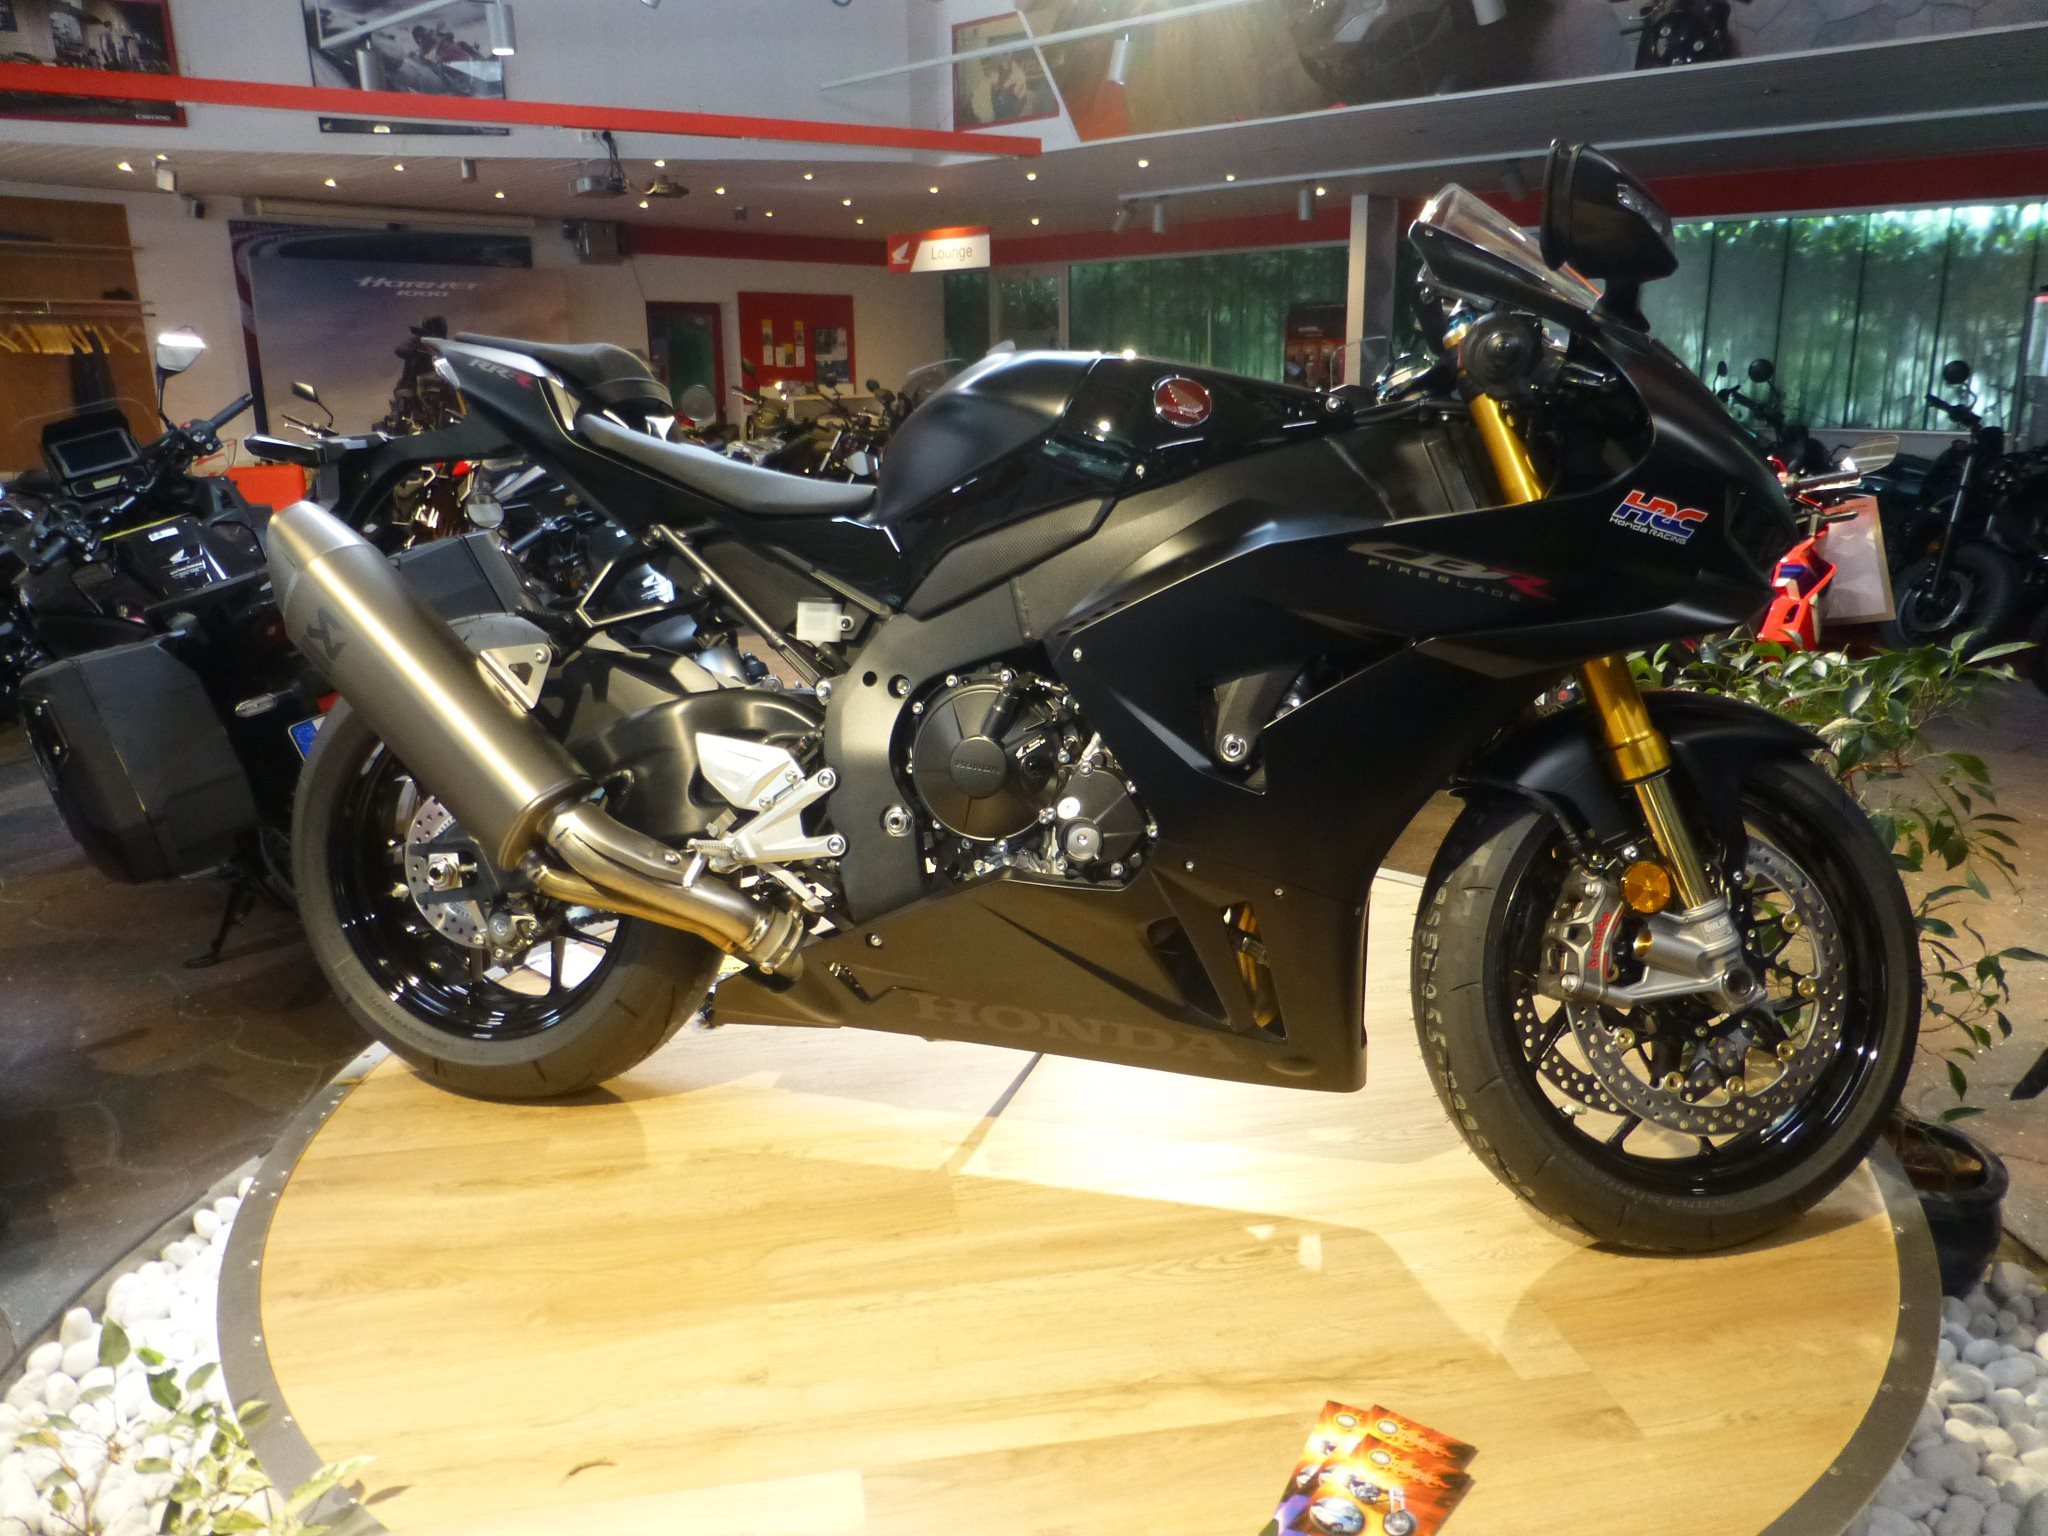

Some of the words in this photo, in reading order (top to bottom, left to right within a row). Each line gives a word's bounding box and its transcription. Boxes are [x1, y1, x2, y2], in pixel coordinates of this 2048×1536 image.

[931, 246, 973, 262] Lounge
[1609, 516, 1649, 534] Honda
[1648, 529, 1687, 545] RACING
[1612, 489, 1709, 539] HRC
[1368, 558, 1521, 602] FIREBLADE
[1588, 911, 1612, 969] brembo
[909, 992, 1248, 1065] HONDA
